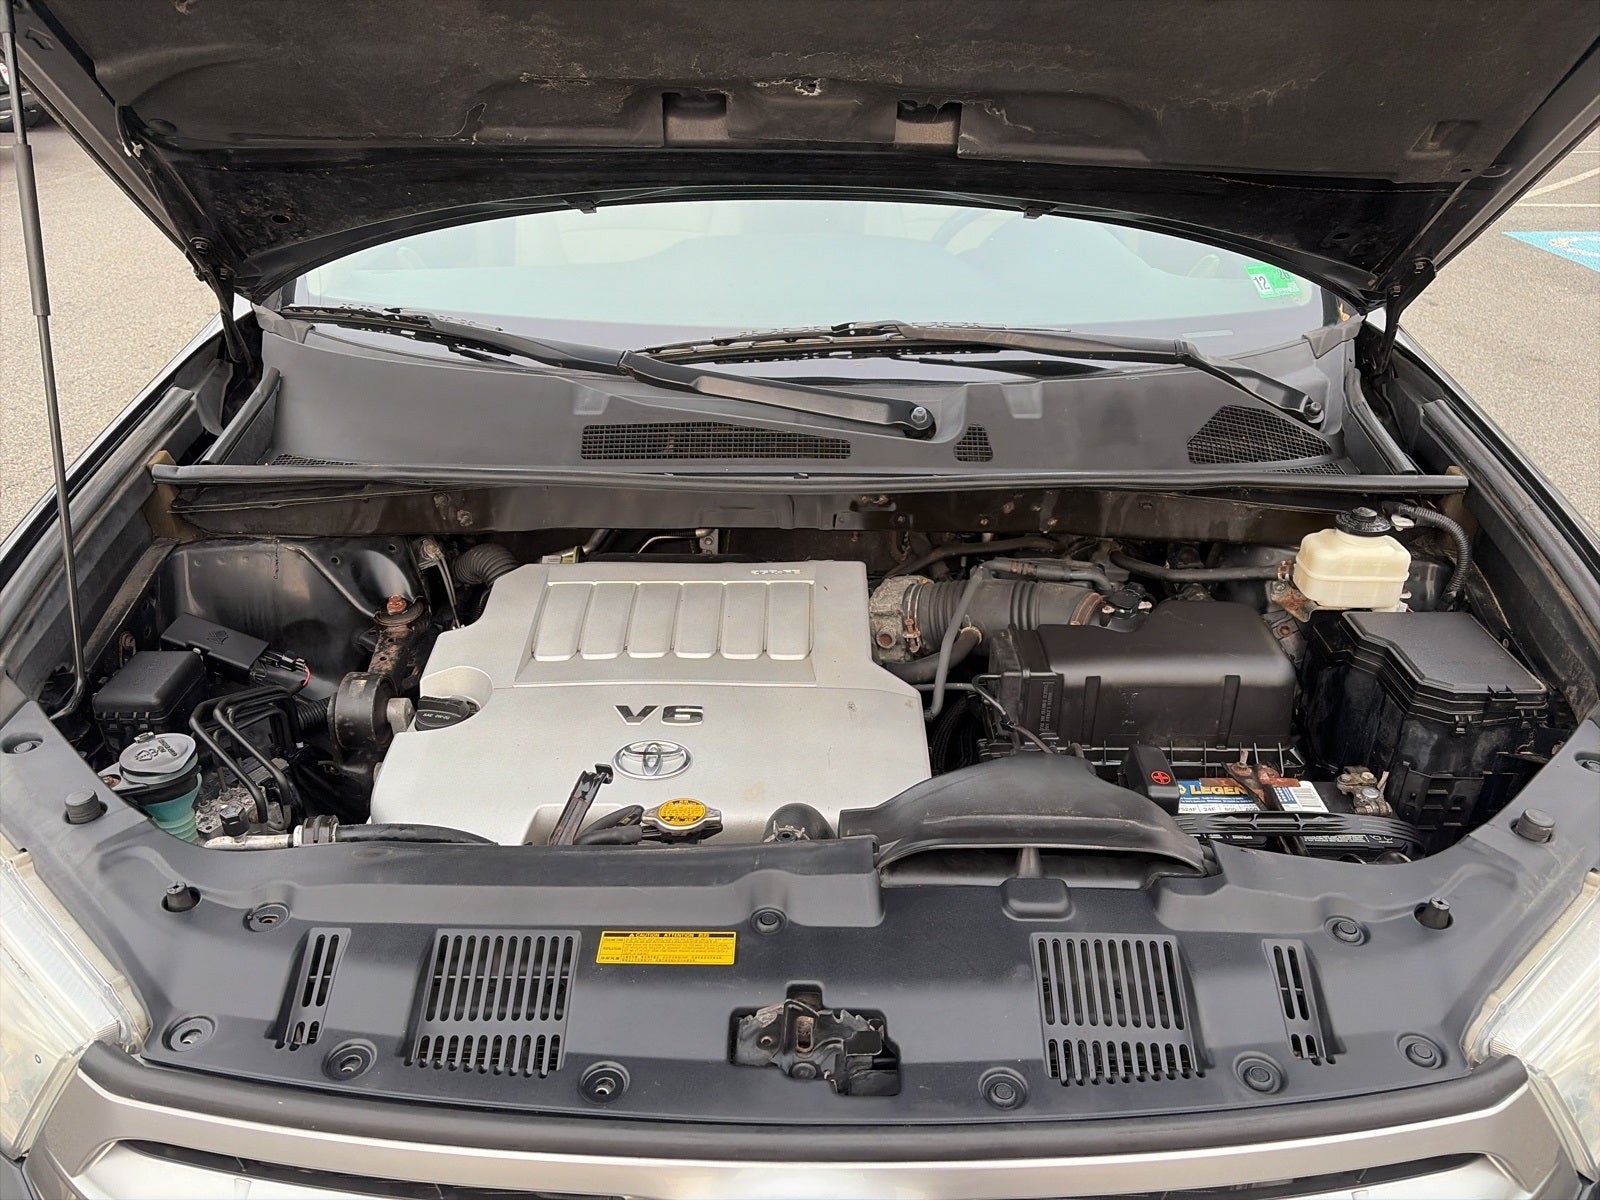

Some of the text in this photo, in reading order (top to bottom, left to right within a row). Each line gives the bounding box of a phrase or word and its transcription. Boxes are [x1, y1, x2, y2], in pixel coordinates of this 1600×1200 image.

[1252, 276, 1271, 291] 12
[613, 705, 704, 726] V6
[1190, 784, 1249, 796] LEGEN
